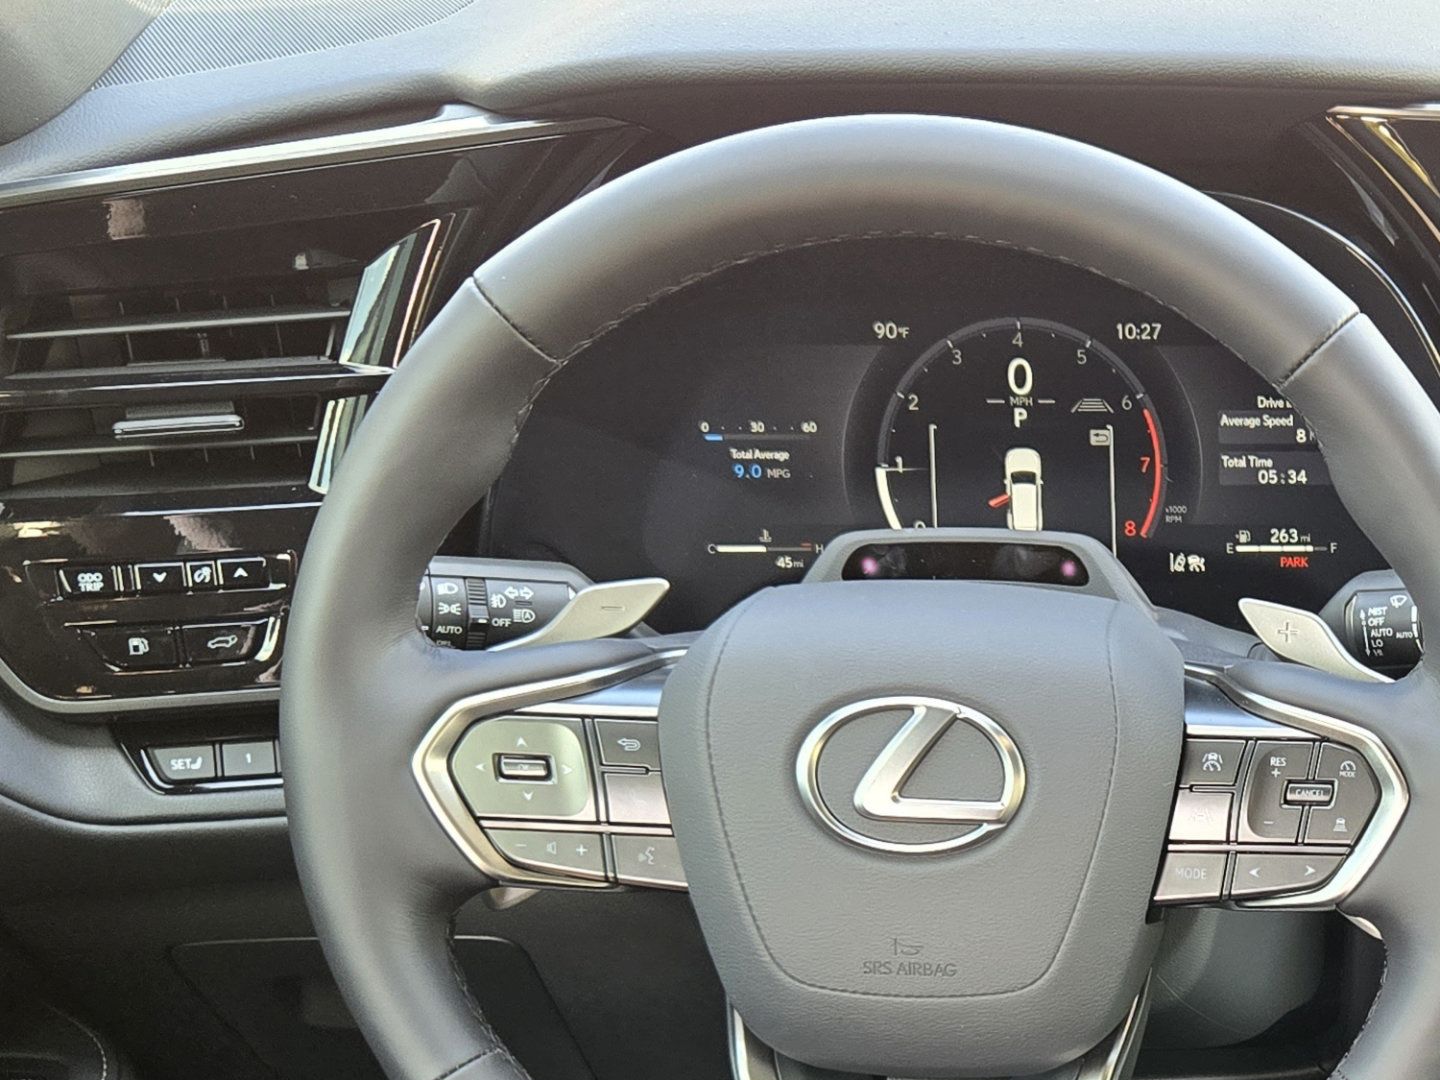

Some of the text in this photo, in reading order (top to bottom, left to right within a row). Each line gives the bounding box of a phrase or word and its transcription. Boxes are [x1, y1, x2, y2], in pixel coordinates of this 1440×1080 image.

[1116, 322, 1162, 341] 10:27
[1012, 335, 1024, 348] 4
[952, 350, 962, 365] 3
[1076, 350, 1087, 365] 5
[1006, 357, 1034, 396] 0
[908, 394, 919, 411] 2
[1009, 396, 1033, 407] MPH
[1121, 395, 1132, 410] 6
[1257, 395, 1285, 409] Drive
[1013, 407, 1028, 428] P
[1220, 413, 1294, 429] Average Speed
[700, 421, 710, 433] 0
[750, 420, 765, 433] 30
[801, 420, 817, 433] 60
[1295, 428, 1307, 443] 8
[729, 447, 790, 462] Total Average
[1221, 454, 1273, 468] Total Time
[732, 463, 791, 479] 9.0 MPG
[1140, 456, 1151, 473] 7
[1258, 469, 1308, 485] 05:34
[1124, 520, 1136, 537] 8
[1270, 527, 1299, 543] 263
[815, 544, 824, 554] H
[1226, 542, 1234, 554] E
[1330, 542, 1338, 553] F
[1279, 556, 1309, 568] PARK
[491, 617, 512, 627] OFF
[1367, 616, 1385, 627] OFF
[435, 625, 463, 635] AUTO
[1370, 627, 1393, 638] AUTO
[1395, 631, 1413, 639] AUTO
[1371, 639, 1384, 648] LO
[170, 758, 192, 770] SET
[1269, 756, 1287, 767] RES
[1295, 788, 1325, 798] CANCEL
[1174, 868, 1208, 880] MODE
[863, 960, 959, 977] SRS AIRBAG
